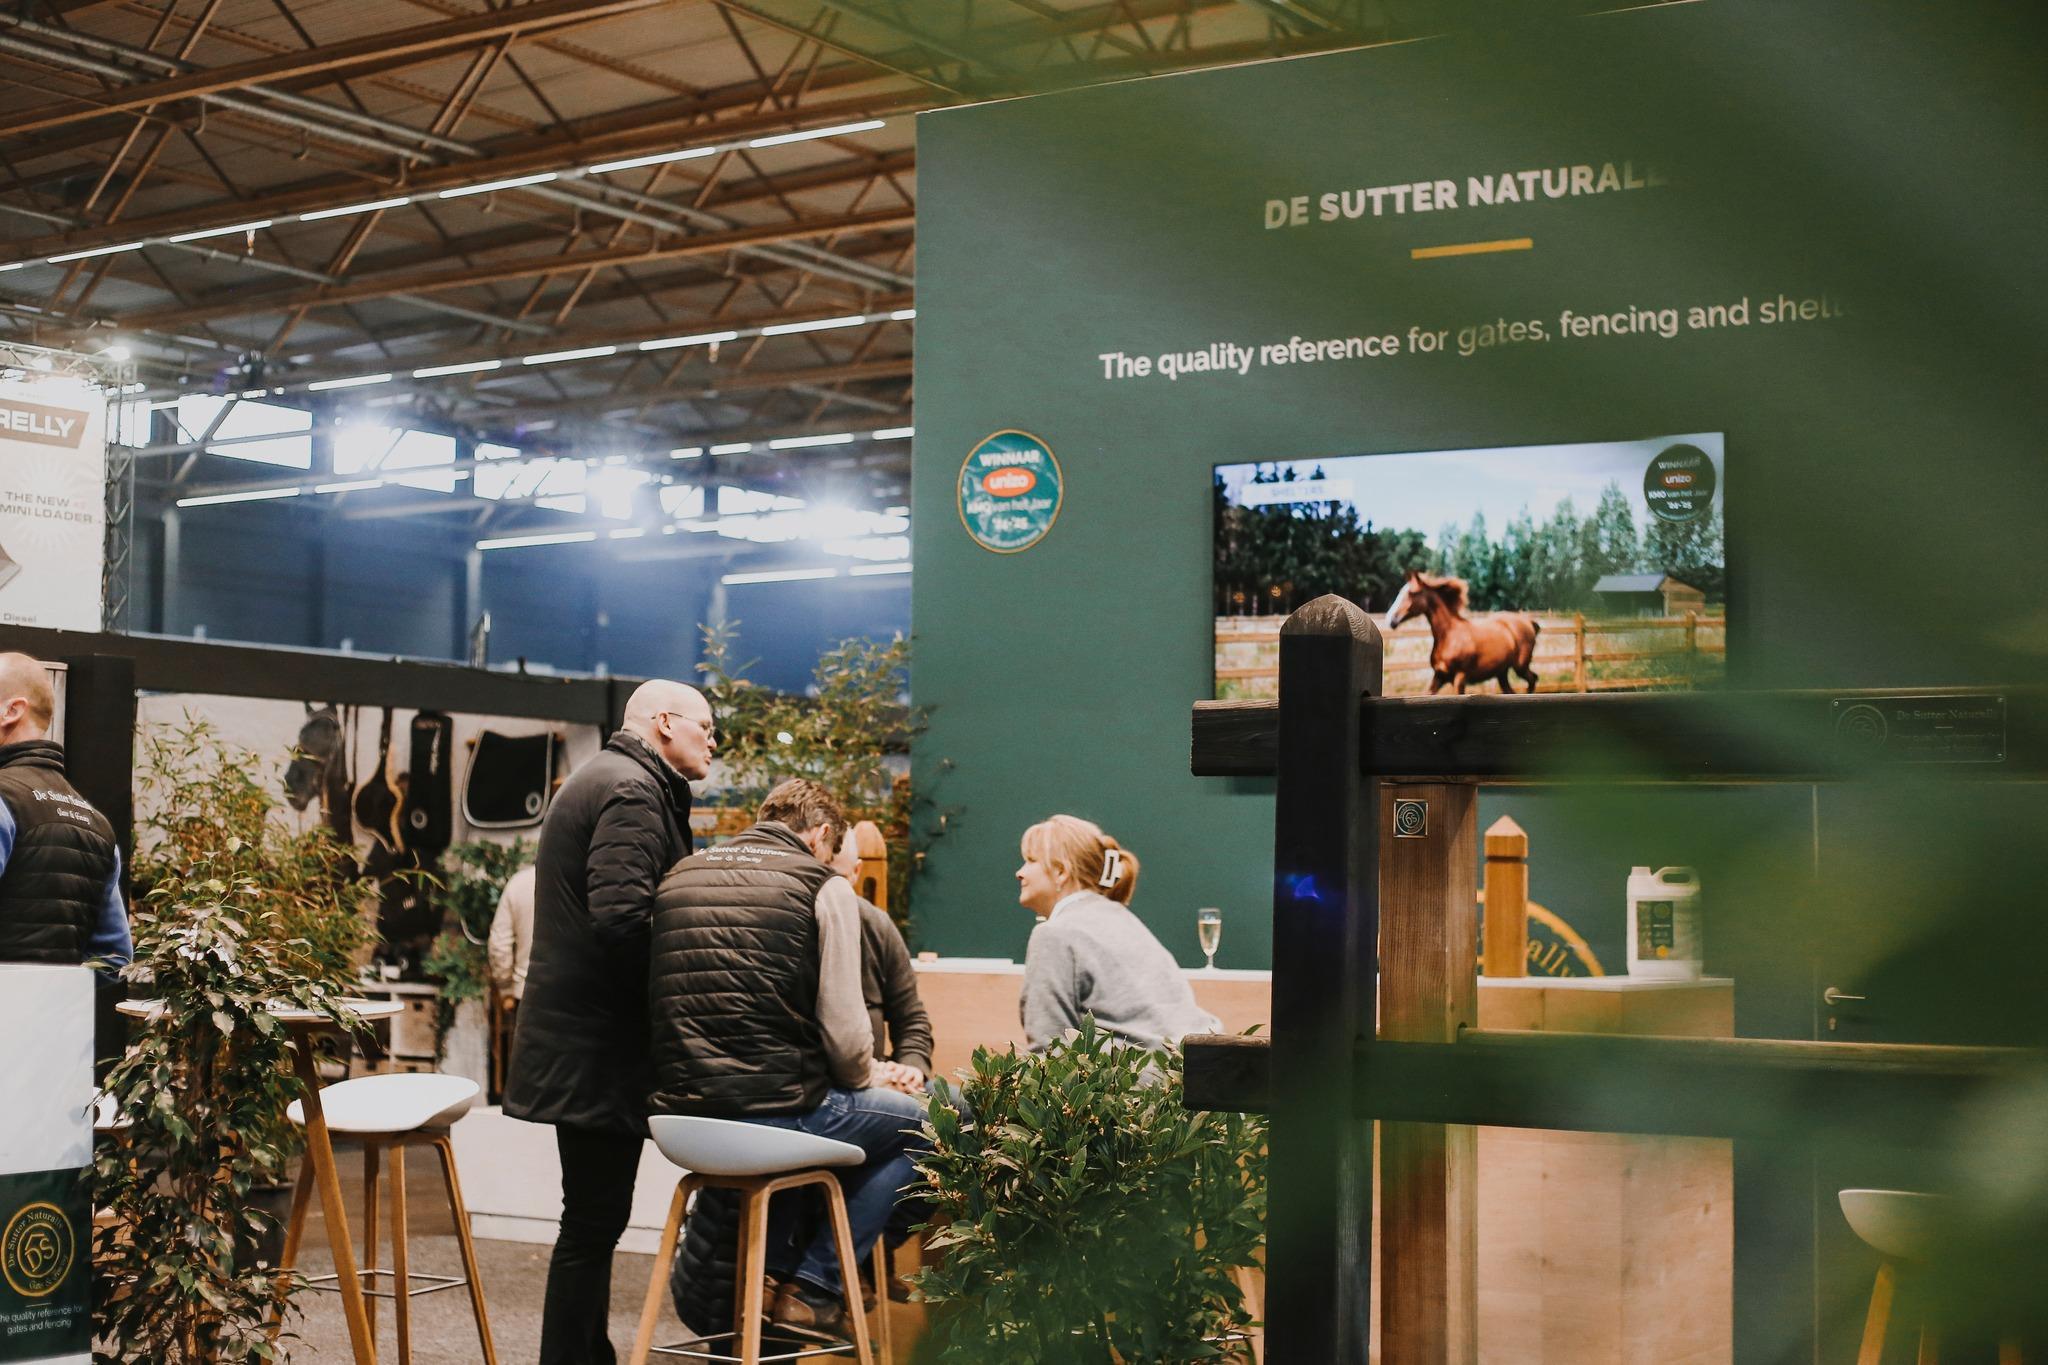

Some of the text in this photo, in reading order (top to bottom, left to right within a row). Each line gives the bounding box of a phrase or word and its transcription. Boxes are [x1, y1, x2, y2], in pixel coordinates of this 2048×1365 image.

[1265, 160, 1672, 230] DE SUTTER NATURALL
[1099, 351, 1152, 379] The
[1157, 343, 1253, 380] quality
[1260, 336, 1400, 366] reference
[1407, 326, 1448, 353] for
[1457, 317, 1550, 356] gates,
[1559, 305, 1680, 338] fencing
[1687, 297, 1750, 329] and
[979, 449, 1040, 467] WINNAAR
[989, 472, 1029, 489] unizo
[1665, 473, 1692, 484] unizo
[4, 491, 70, 507] THE NEW
[0, 504, 93, 524] MINI LOADER
[4, 613, 37, 623] Diesel
[32, 789, 47, 801] De
[709, 846, 741, 854] Sutter
[8, 1220, 27, 1251] Sutter
[0, 1313, 10, 1323] he
[11, 1310, 35, 1324] quality
[7, 1319, 72, 1336] gates and fencing
